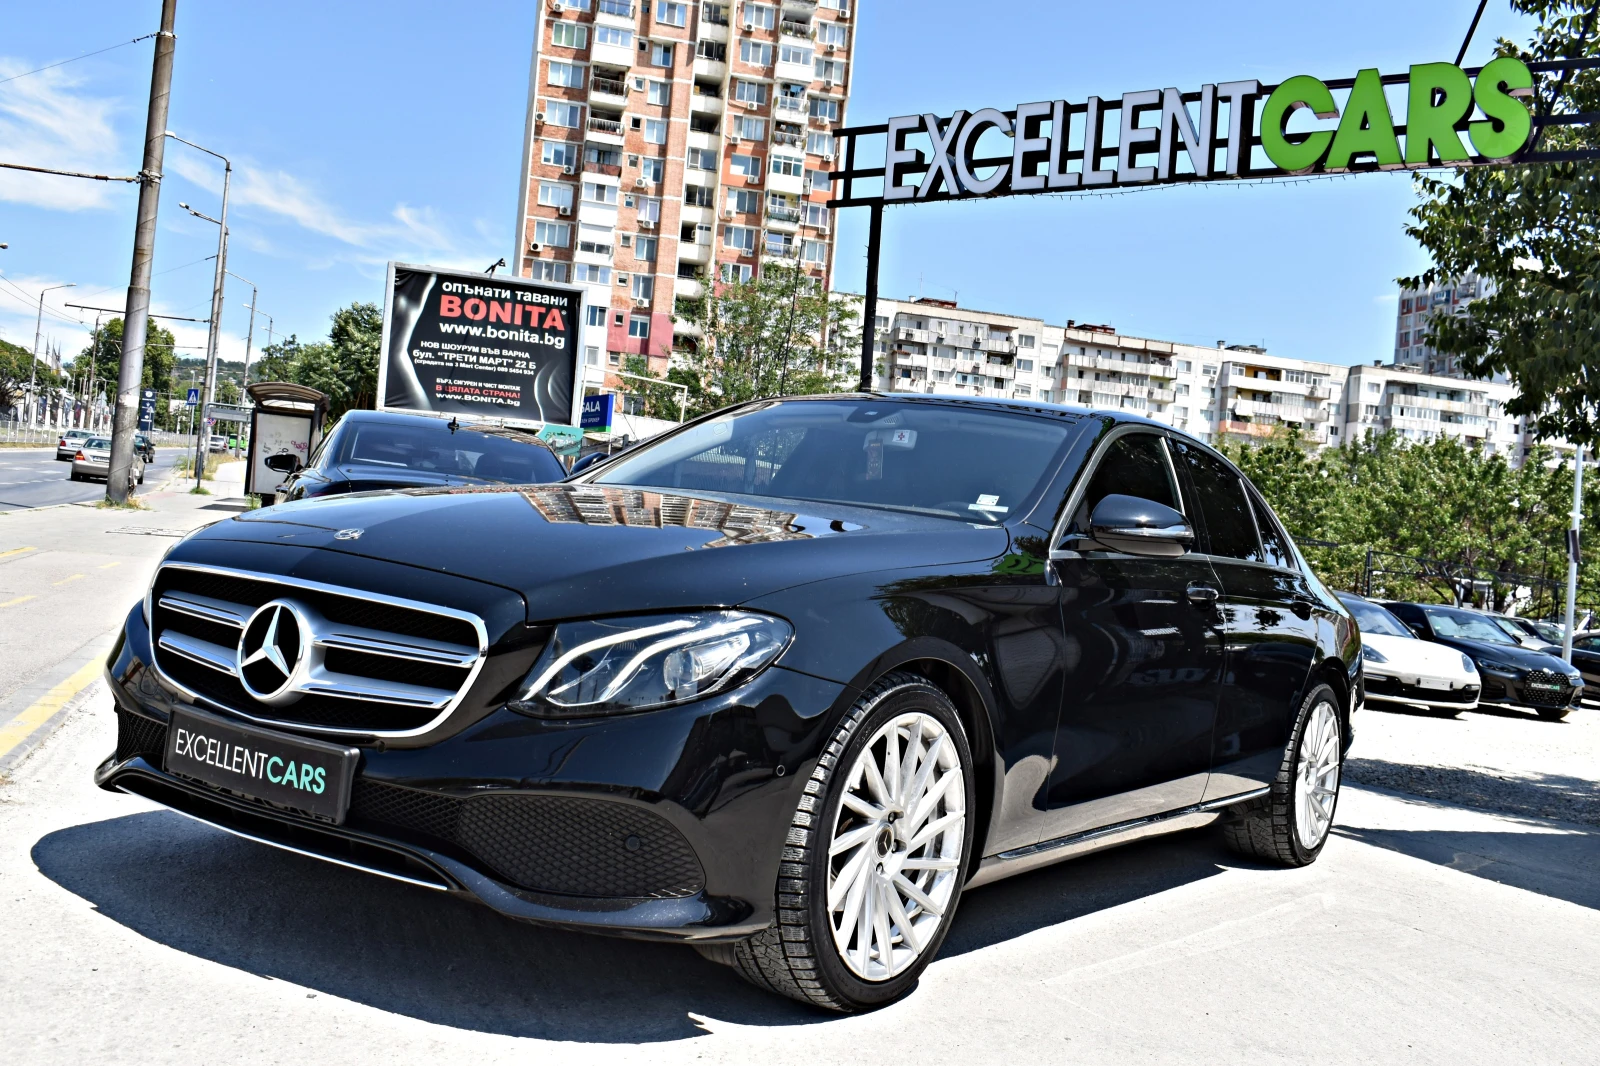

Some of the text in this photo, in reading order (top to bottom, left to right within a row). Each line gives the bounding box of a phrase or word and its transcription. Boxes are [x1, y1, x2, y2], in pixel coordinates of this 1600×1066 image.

[442, 281, 568, 306] опънати тавани
[439, 323, 565, 349] www.bonita.bg
[412, 349, 435, 359] бул.
[515, 360, 527, 369] 22
[420, 340, 530, 359] НОВ ШОУРУМ ВЪВ ВАРНА
[435, 392, 521, 407] www.BONITA.bg
[444, 385, 481, 395] ЦЯЛАТА
[482, 389, 521, 399] СТРАНА!
